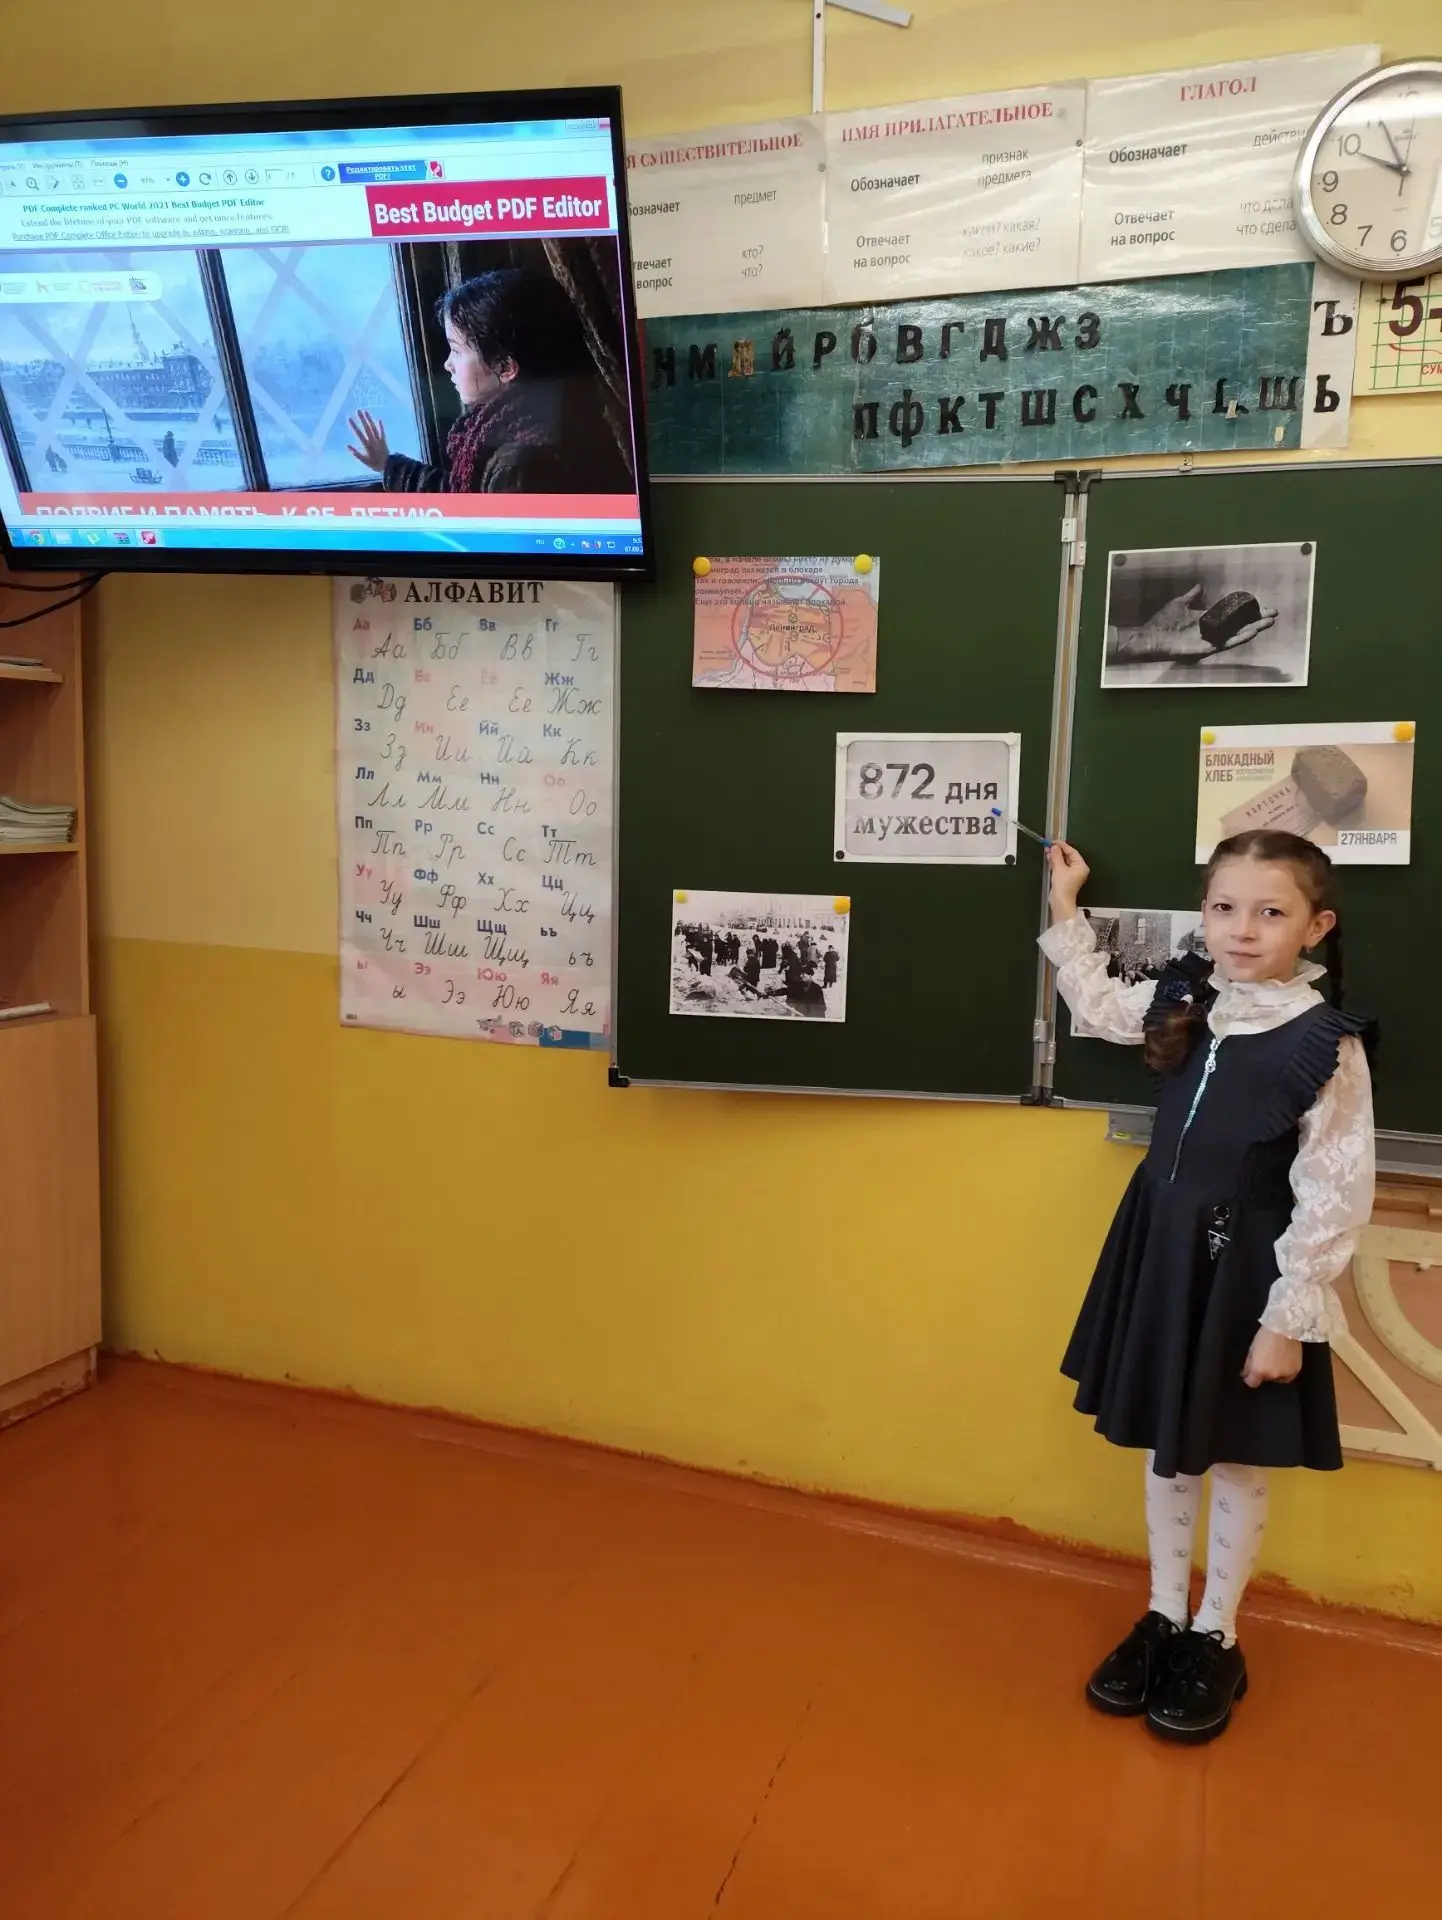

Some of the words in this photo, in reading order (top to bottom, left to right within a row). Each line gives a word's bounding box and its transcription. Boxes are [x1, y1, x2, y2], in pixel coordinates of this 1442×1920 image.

[1180, 77, 1257, 102] ГЛАГОЛ
[842, 125, 880, 142] ИМЯ
[885, 102, 1053, 137] ПРИЛАГАТЕЛЬНОЕ
[640, 133, 804, 168] СУЩЕСТВИТЕЛЬНОЕ
[1109, 143, 1188, 164] Обозначает
[1338, 133, 1361, 157] 10
[982, 148, 1029, 166] признак
[851, 173, 921, 192] Обозначает
[977, 168, 1032, 189] предмета
[1322, 170, 1339, 192] 9
[23, 204, 38, 213] PDF
[41, 202, 78, 214] Complete
[80, 203, 107, 212] ranked
[122, 201, 147, 210] World
[171, 201, 189, 209] Best
[191, 200, 220, 210] Budget
[240, 198, 264, 206] Editor
[734, 189, 777, 208] предмет
[374, 201, 419, 224] Best
[423, 200, 492, 227] Budget
[497, 197, 537, 220] PDF
[543, 194, 602, 218] Editor
[1114, 210, 1174, 226] Отвечает
[1330, 204, 1348, 225] 8
[856, 234, 911, 249] Отвечает
[1110, 234, 1127, 246] на
[1129, 230, 1175, 246] вопрос
[1357, 225, 1373, 246] 7
[1390, 230, 1407, 252] 6
[742, 245, 764, 260] кто?
[853, 257, 868, 269] на
[870, 253, 911, 269] вопрос
[741, 264, 763, 279] что?
[636, 276, 673, 292] вопрос
[404, 581, 544, 604] АЛФАВИТ
[414, 617, 432, 631] Бб
[478, 618, 496, 632] Вв
[545, 618, 559, 632] Гг
[372, 632, 407, 659] Аа
[353, 668, 374, 684] Дд
[544, 672, 574, 686] Жж
[354, 718, 371, 732] Зз
[543, 724, 562, 738] Кк
[1205, 751, 1275, 768] БЛОКАДНЫЙ
[355, 766, 375, 780] Лл
[417, 770, 442, 784] Мм
[480, 772, 500, 786] Нн
[859, 762, 936, 800] 872
[945, 782, 998, 804] дня
[1205, 769, 1233, 782] ХЛЕБ
[355, 816, 373, 830] Пп
[414, 820, 433, 834] Рр
[477, 822, 494, 836] Сс
[542, 824, 558, 838] Тт
[853, 814, 998, 841] мужества
[414, 868, 438, 884] Фф
[477, 872, 494, 886] Хх
[542, 875, 563, 892] Цц
[356, 910, 372, 924] Чч
[414, 915, 441, 929] Шш
[477, 919, 507, 936] Щщ
[414, 962, 432, 975] Ээ
[477, 968, 507, 982] Юю
[540, 972, 558, 986] Яя
